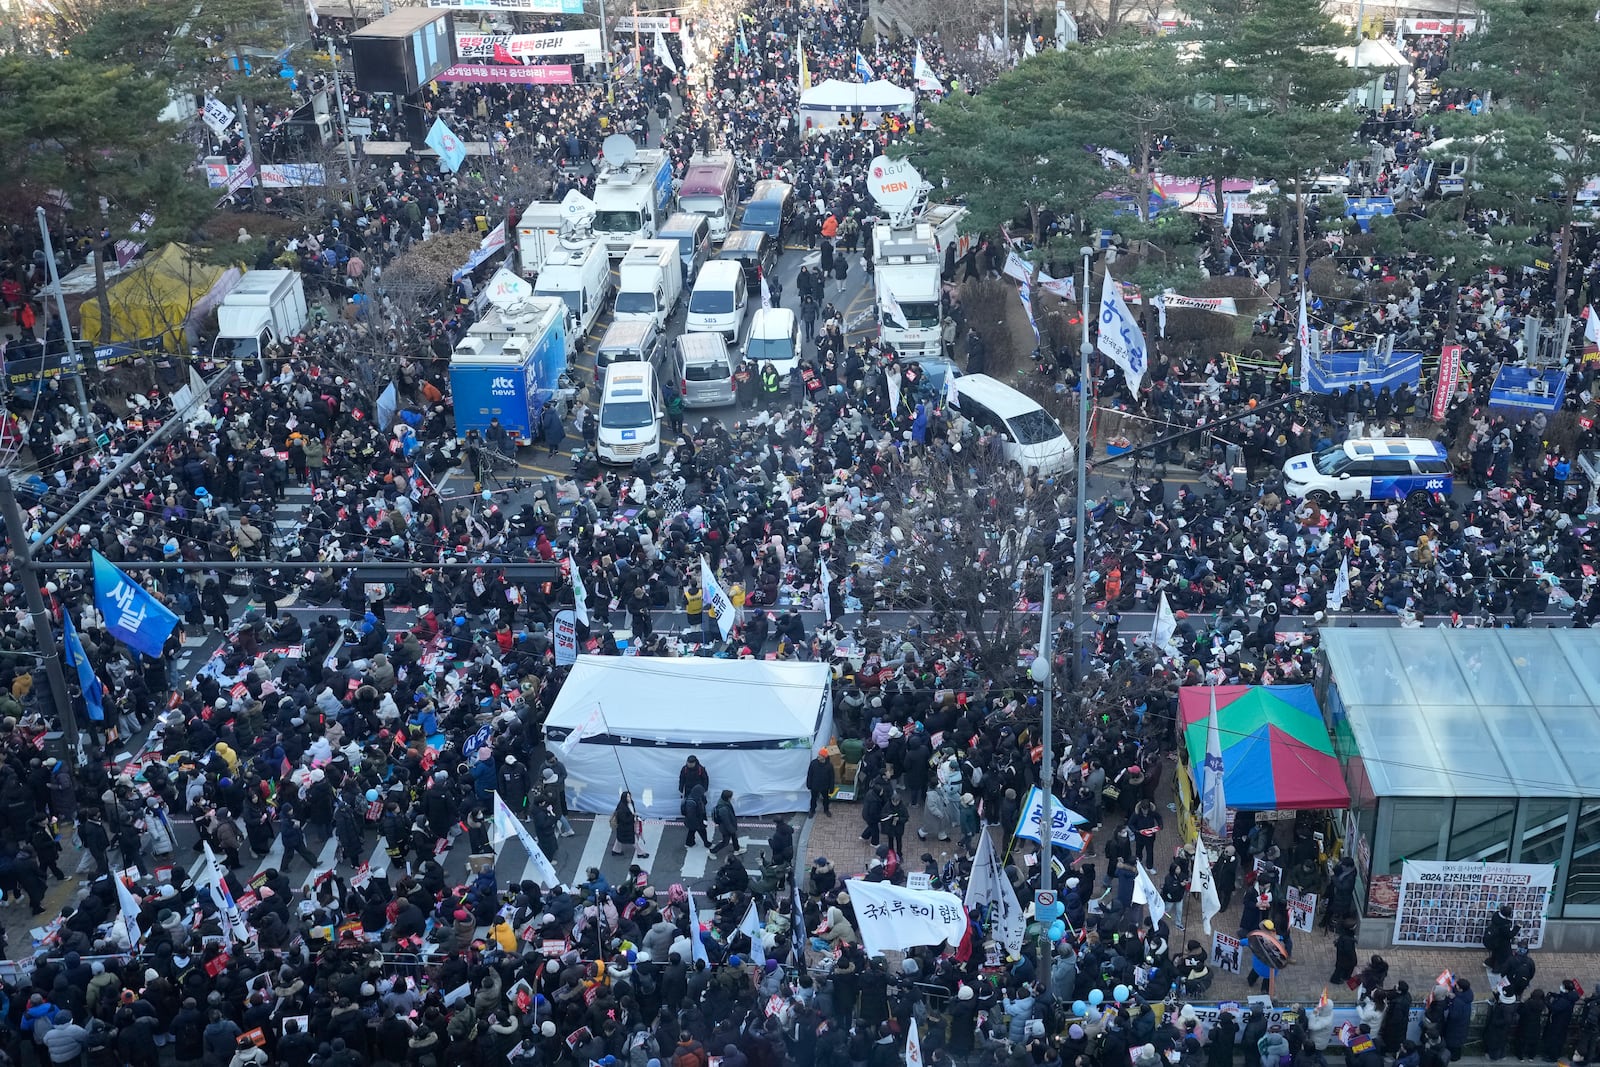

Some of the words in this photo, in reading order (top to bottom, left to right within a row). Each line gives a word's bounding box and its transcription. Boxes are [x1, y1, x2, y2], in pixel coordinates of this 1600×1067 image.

[511, 38, 564, 52] 탄핵하라!
[509, 69, 546, 78] 중단하라!
[881, 181, 908, 194] MBN
[491, 376, 515, 389] jtbc
[1425, 479, 1444, 489] jtbc
[105, 580, 148, 634] 새날
[1420, 873, 1442, 882] 2024
[1443, 873, 1482, 883] 갑진년엔
